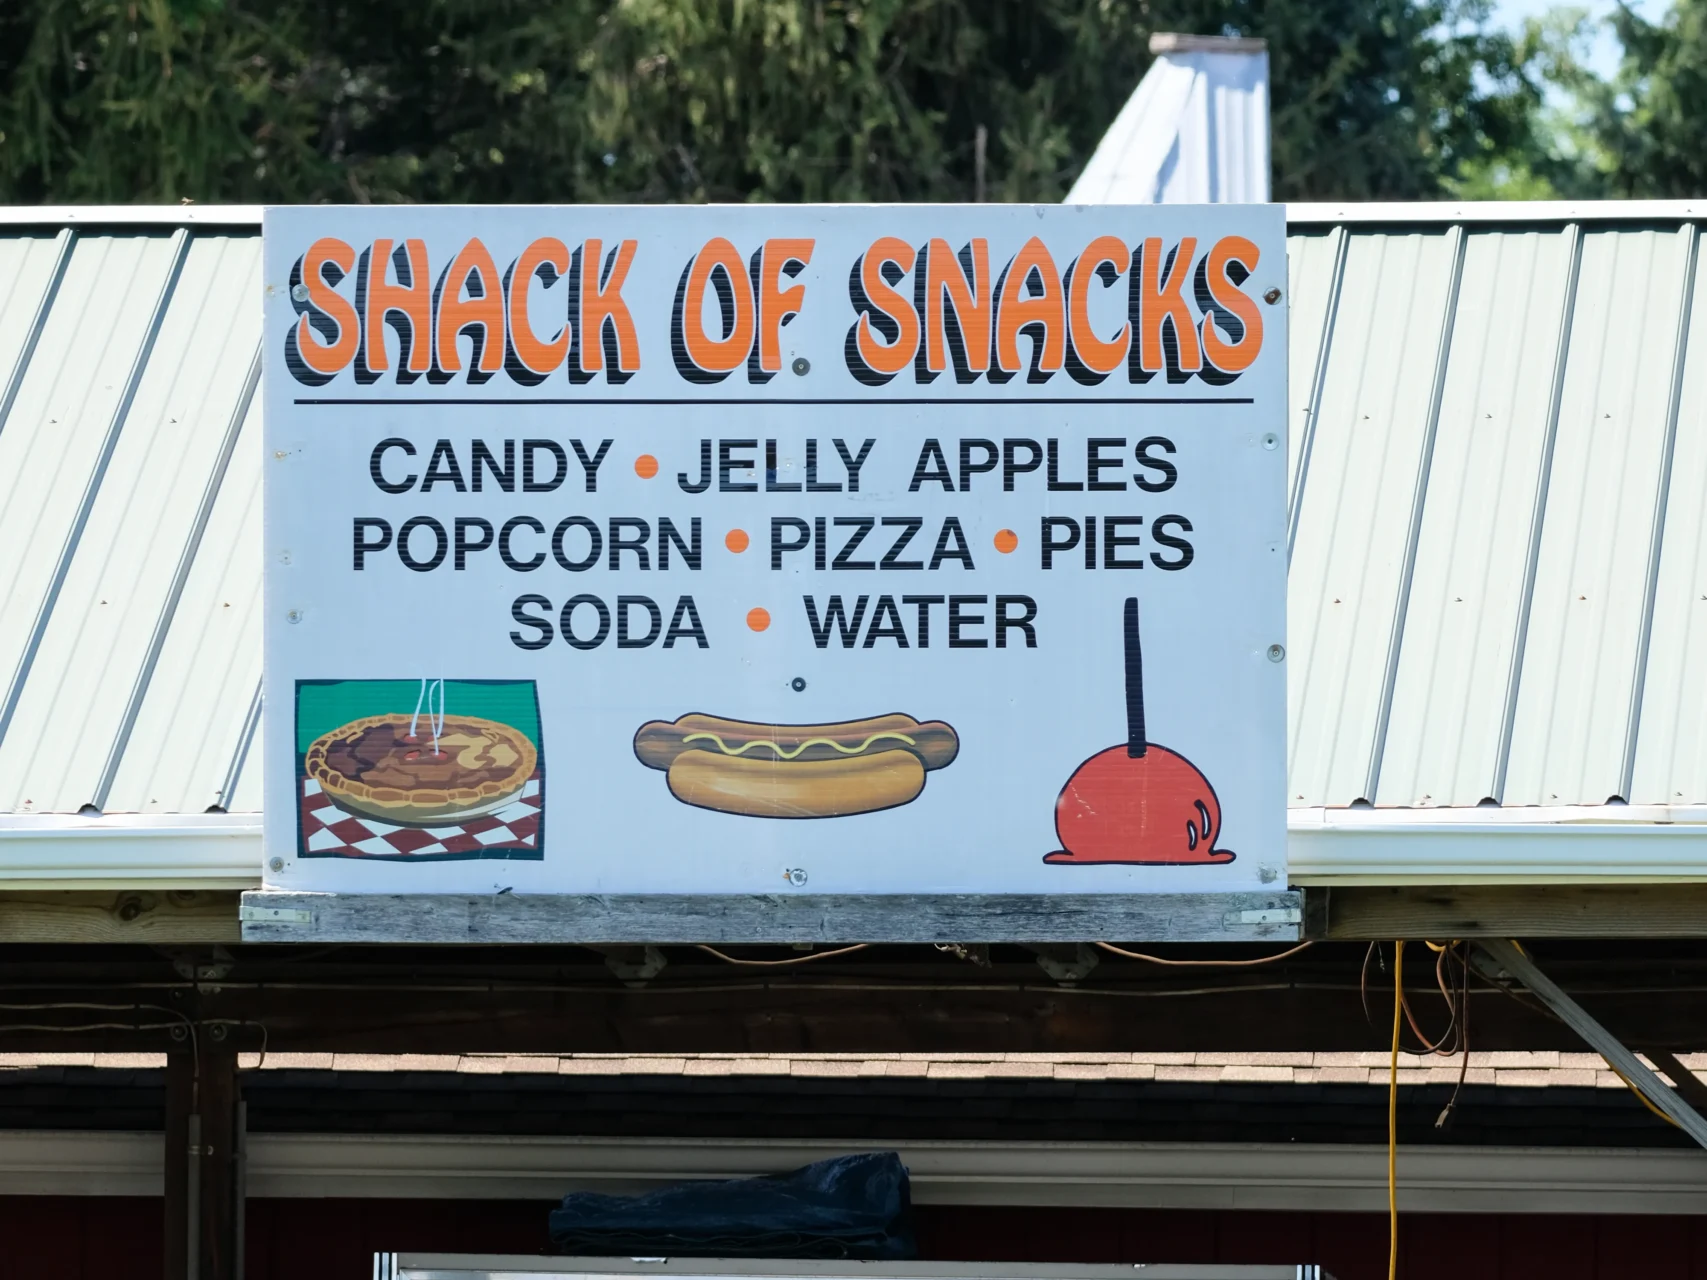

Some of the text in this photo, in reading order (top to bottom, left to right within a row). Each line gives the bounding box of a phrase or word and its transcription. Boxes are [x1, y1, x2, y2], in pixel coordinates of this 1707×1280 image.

[285, 235, 1264, 387] SHACK OF SNACKS
[370, 435, 1178, 494] CANDY JELLY APPLES
[353, 514, 1195, 573] POPCORN PIZZA PIES
[509, 593, 1038, 651] SODA WATER
